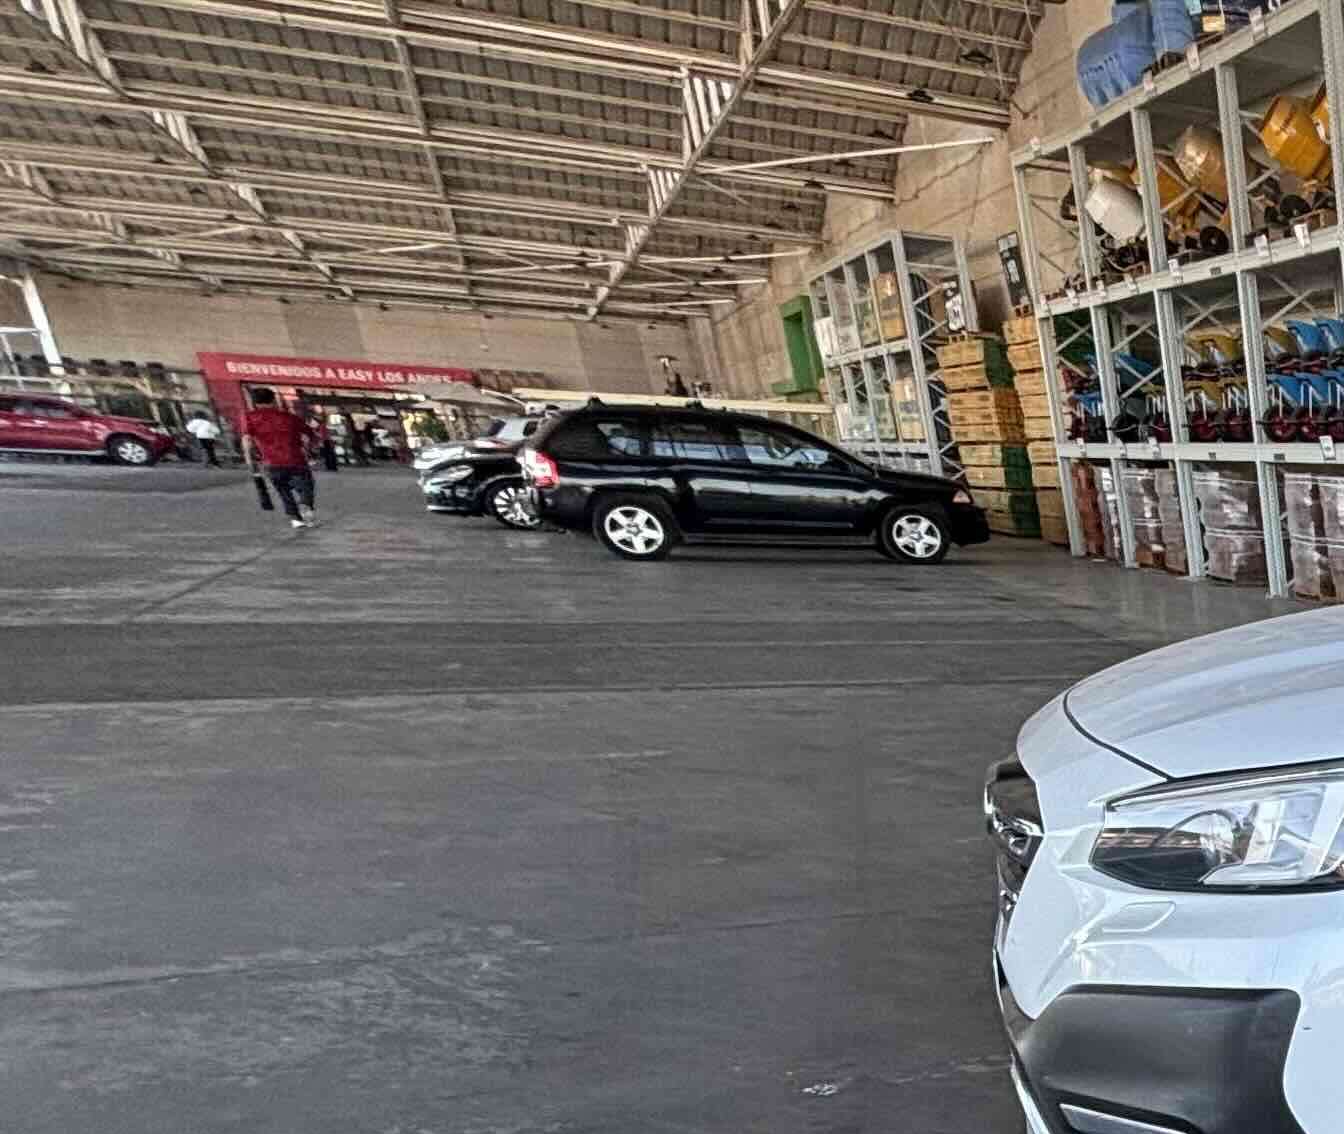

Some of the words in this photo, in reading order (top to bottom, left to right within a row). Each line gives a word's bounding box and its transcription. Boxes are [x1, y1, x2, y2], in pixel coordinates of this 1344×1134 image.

[225, 361, 321, 378] BIENVENIDOS
[325, 368, 337, 380] A
[338, 368, 373, 382] EASY
[376, 371, 405, 384] LOS
